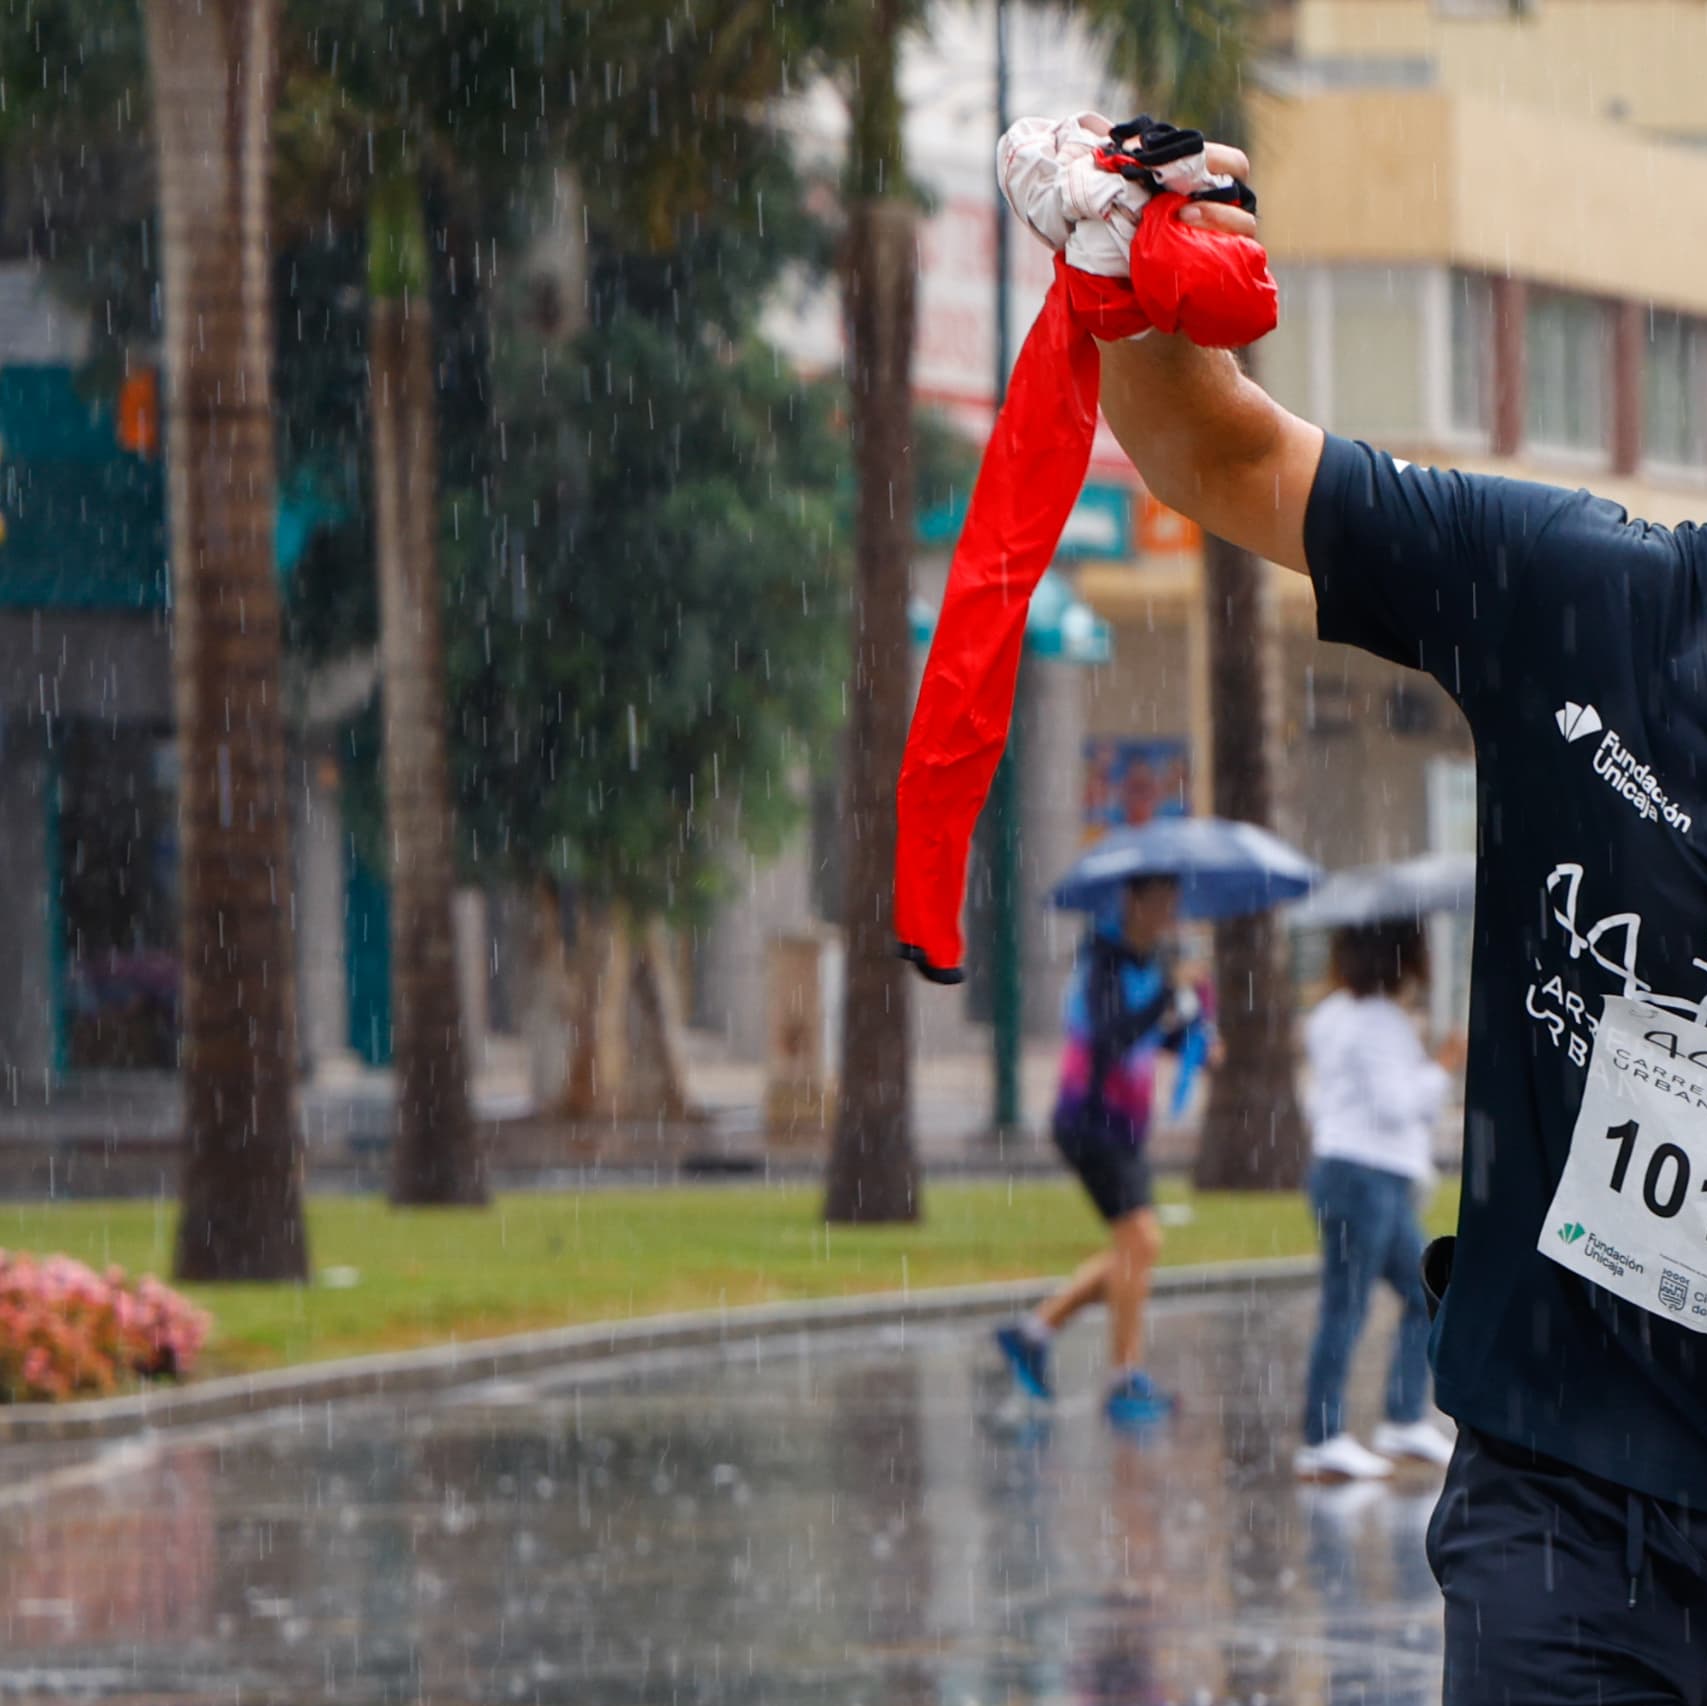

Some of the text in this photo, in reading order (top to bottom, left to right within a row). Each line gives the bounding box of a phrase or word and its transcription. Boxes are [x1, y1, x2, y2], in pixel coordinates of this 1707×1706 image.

[1592, 748, 1659, 824] Unicaja
[1601, 729, 1693, 834] Fundación
[1584, 1244, 1626, 1278] Unicaja
[1588, 1231, 1644, 1275] Fundación
[1691, 1304, 1707, 1319] de
